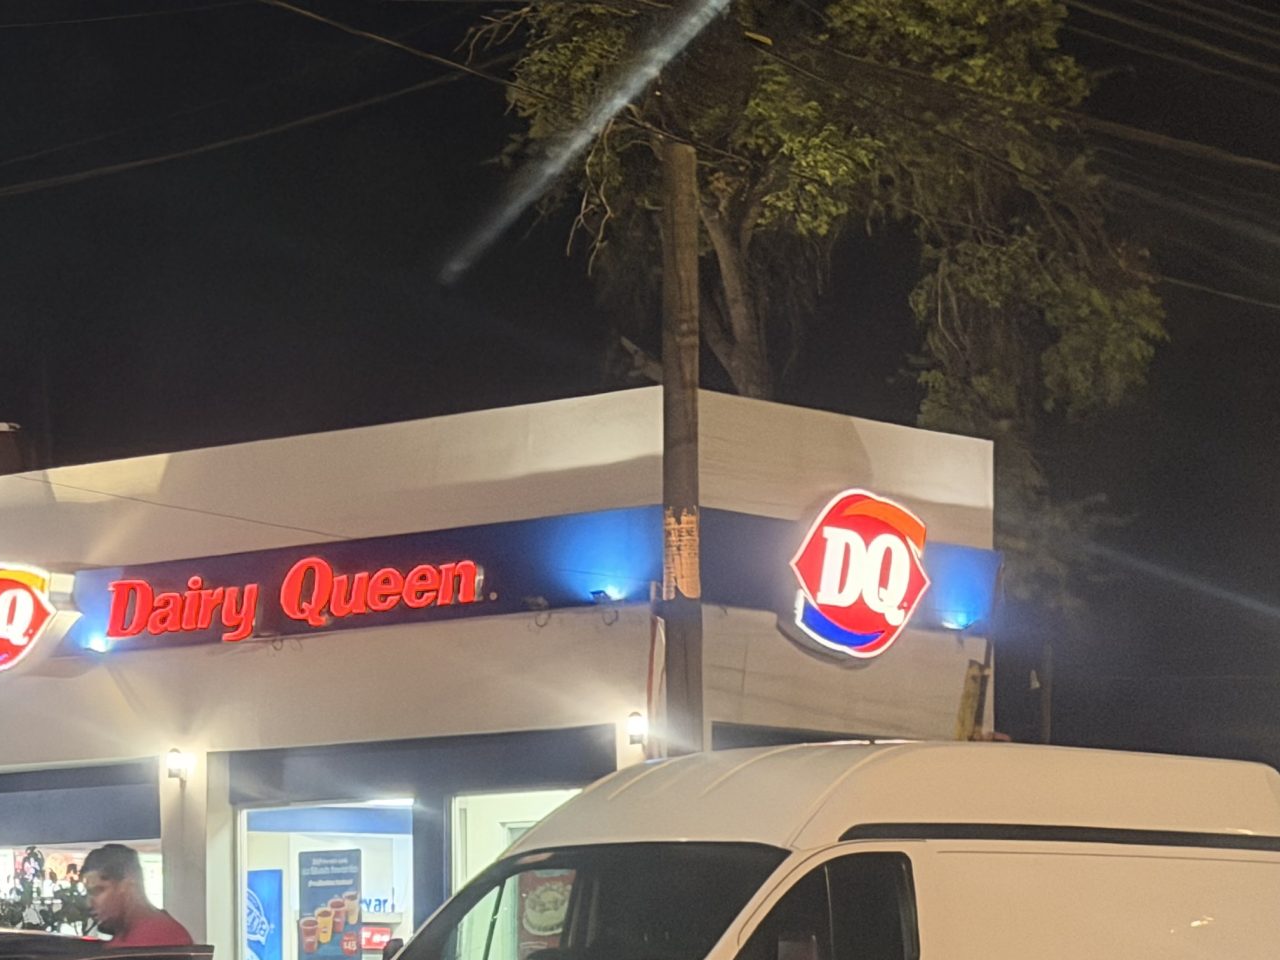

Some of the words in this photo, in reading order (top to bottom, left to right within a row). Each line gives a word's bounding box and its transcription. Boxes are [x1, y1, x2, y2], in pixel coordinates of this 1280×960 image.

[106, 575, 258, 642] Dairy
[280, 556, 477, 627] Queen
[816, 525, 911, 627] DQ
